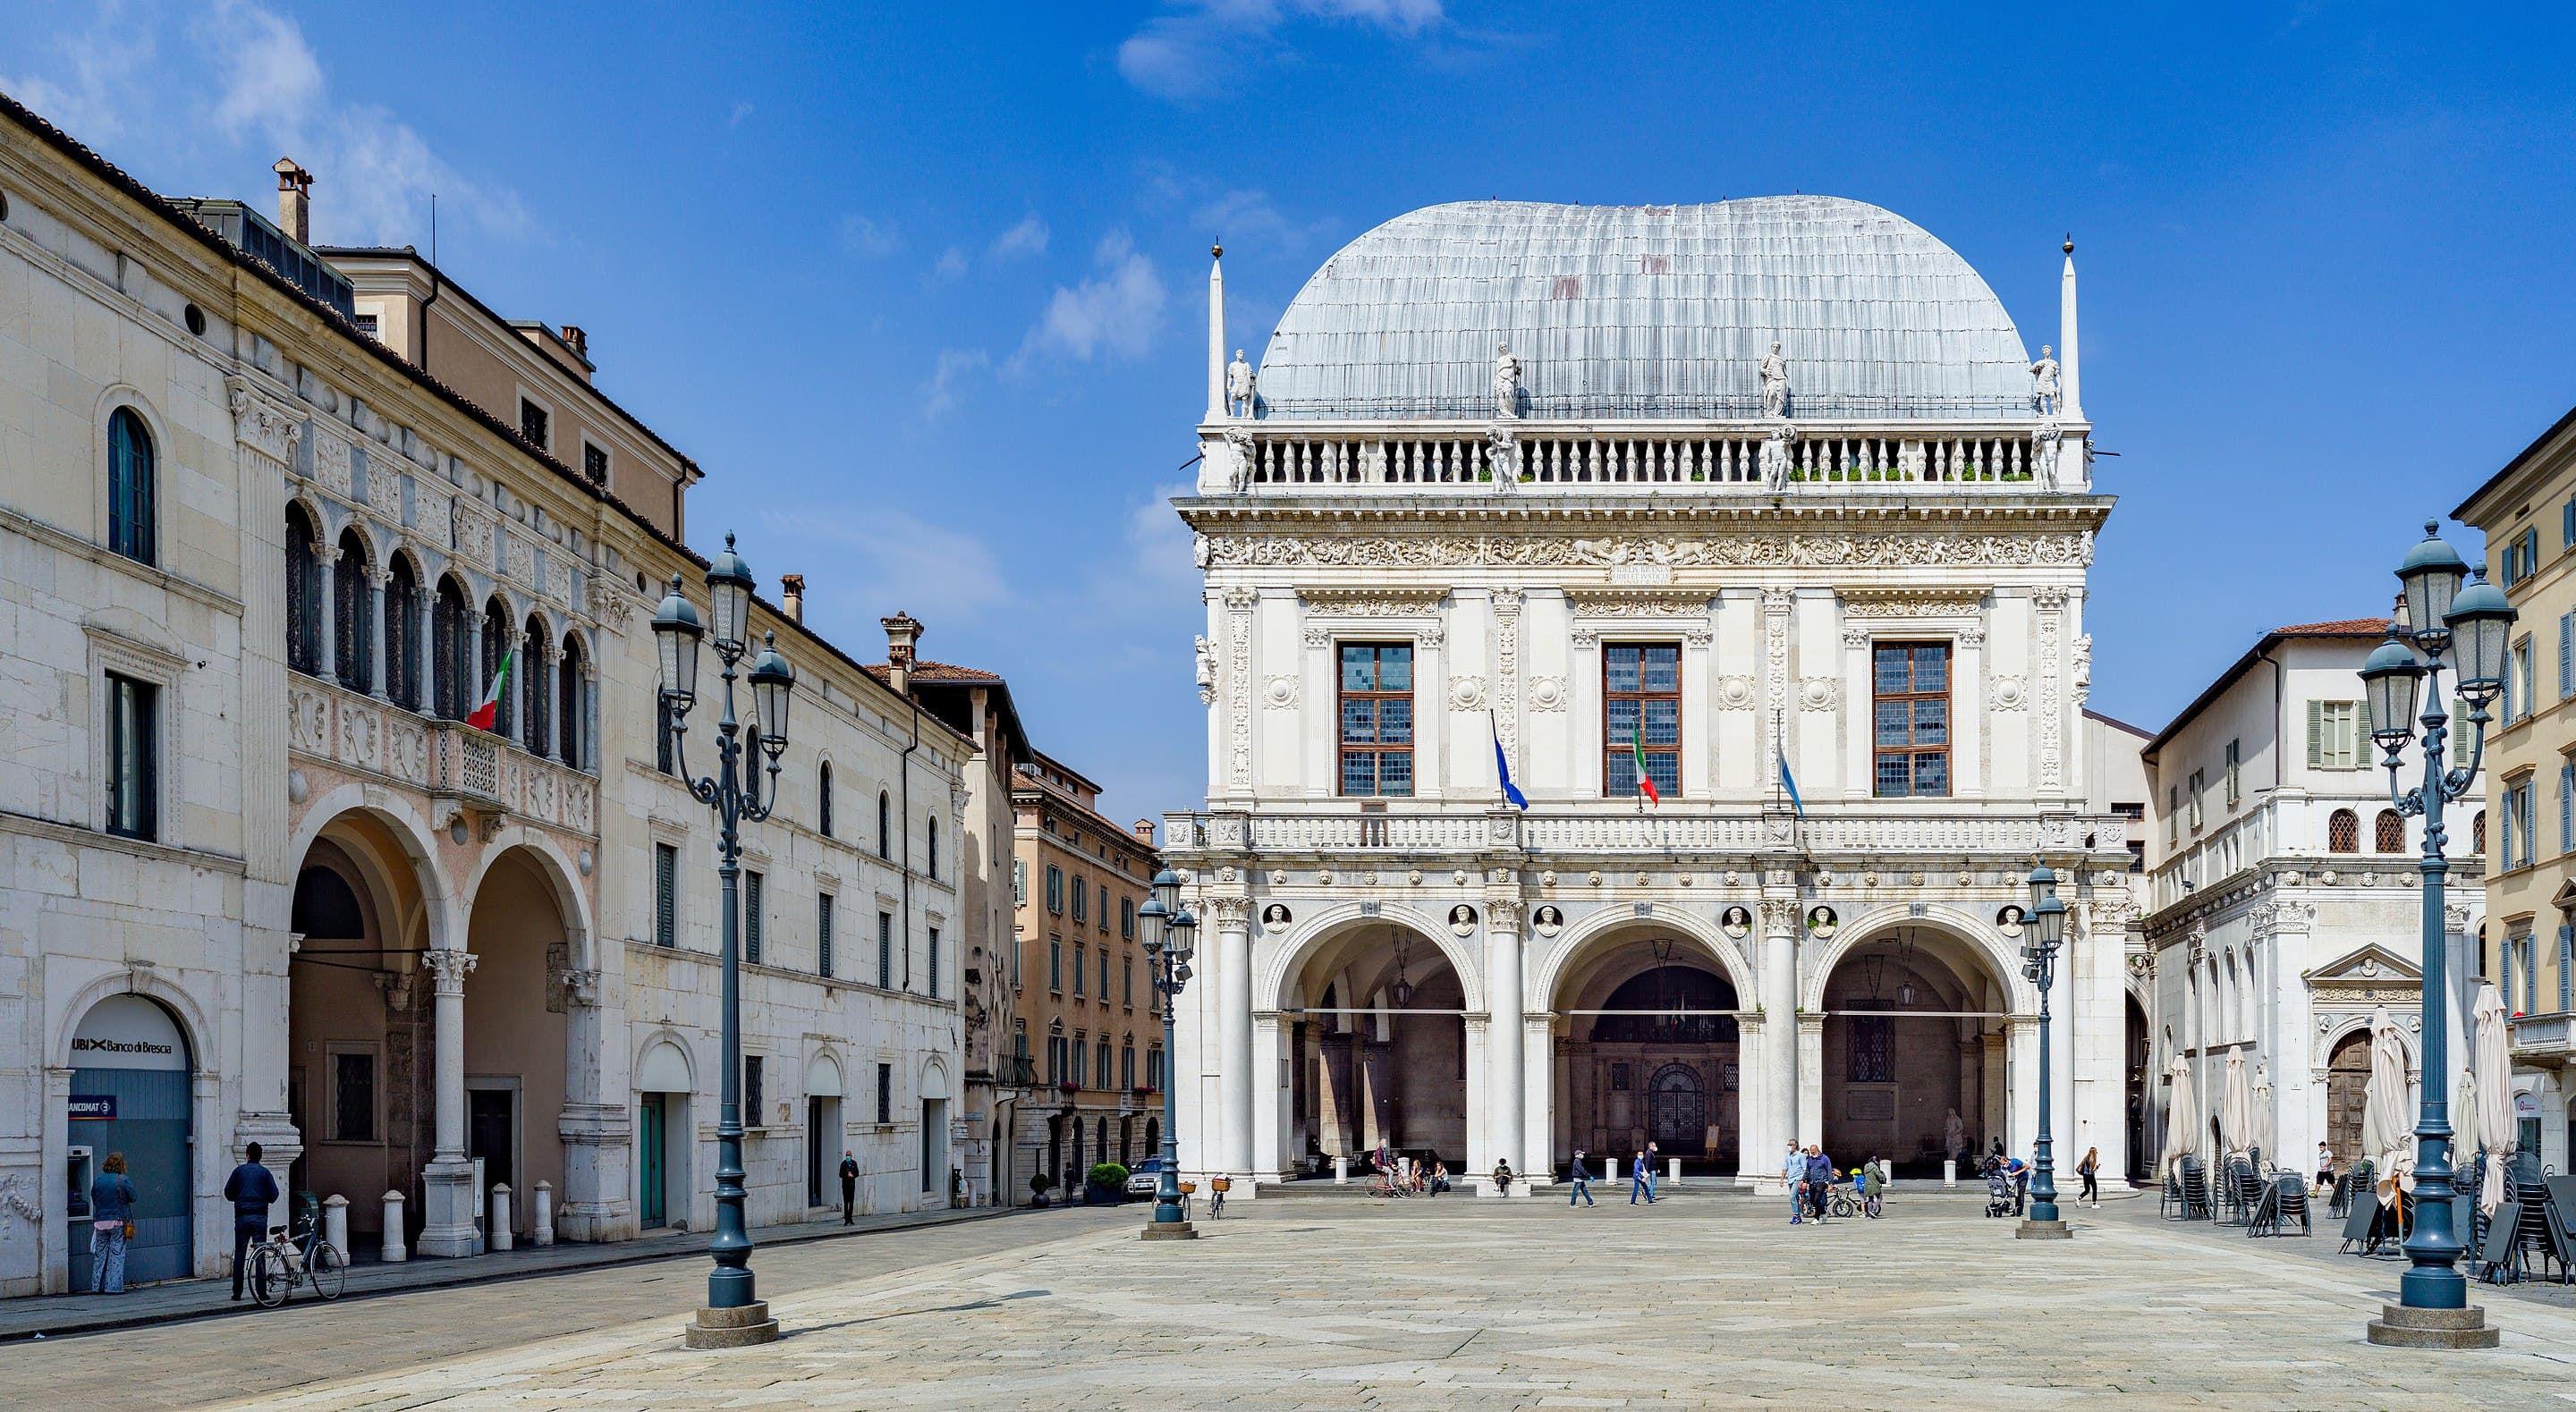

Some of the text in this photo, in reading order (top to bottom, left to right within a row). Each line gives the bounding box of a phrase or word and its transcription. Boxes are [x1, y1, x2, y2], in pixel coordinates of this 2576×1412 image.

[72, 1038, 172, 1054] UBI Banco di Brescia
[68, 1103, 100, 1112] ANCOMAT
